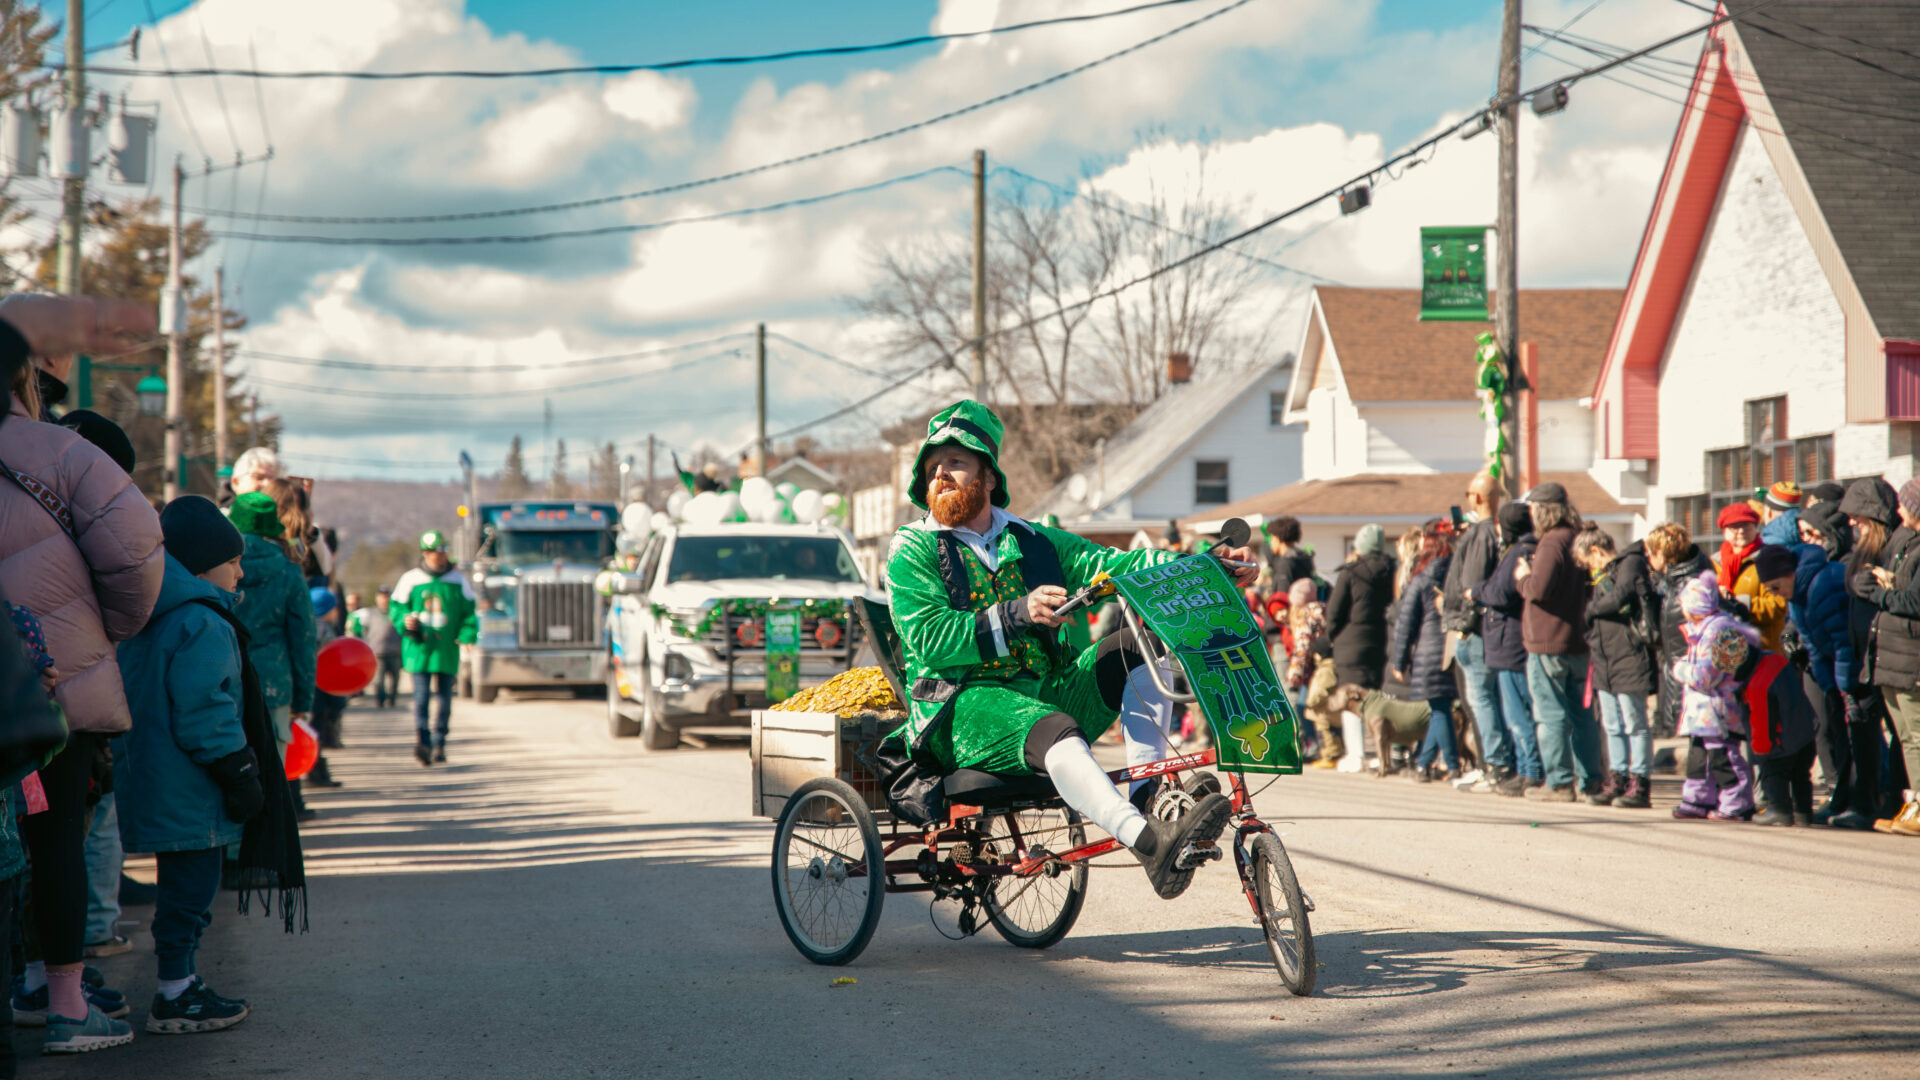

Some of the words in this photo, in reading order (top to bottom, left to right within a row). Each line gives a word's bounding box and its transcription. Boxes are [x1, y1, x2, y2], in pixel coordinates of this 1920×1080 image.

[1152, 583, 1171, 596] of
[1174, 576, 1204, 589] the
[1156, 587, 1225, 616] Irish
